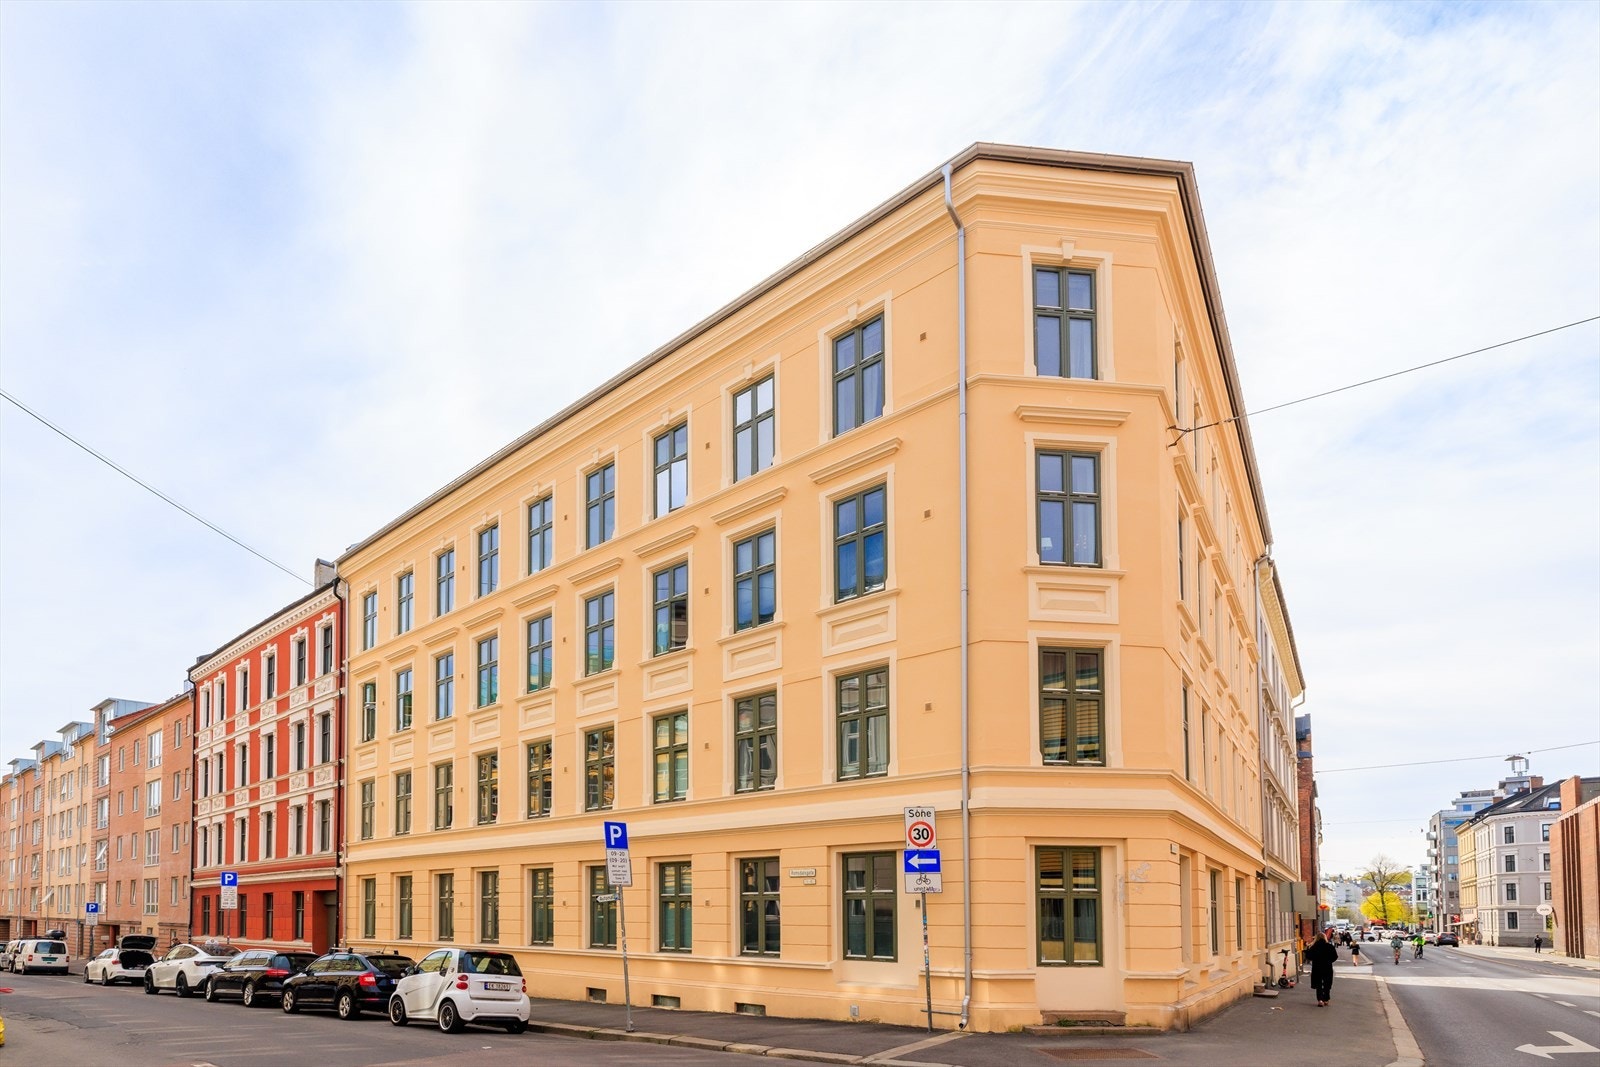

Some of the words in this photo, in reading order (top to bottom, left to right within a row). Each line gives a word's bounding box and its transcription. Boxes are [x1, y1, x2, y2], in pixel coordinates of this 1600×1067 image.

[610, 825, 622, 845] P
[912, 828, 930, 840] 30
[225, 874, 234, 884] P
[88, 904, 96, 912] P
